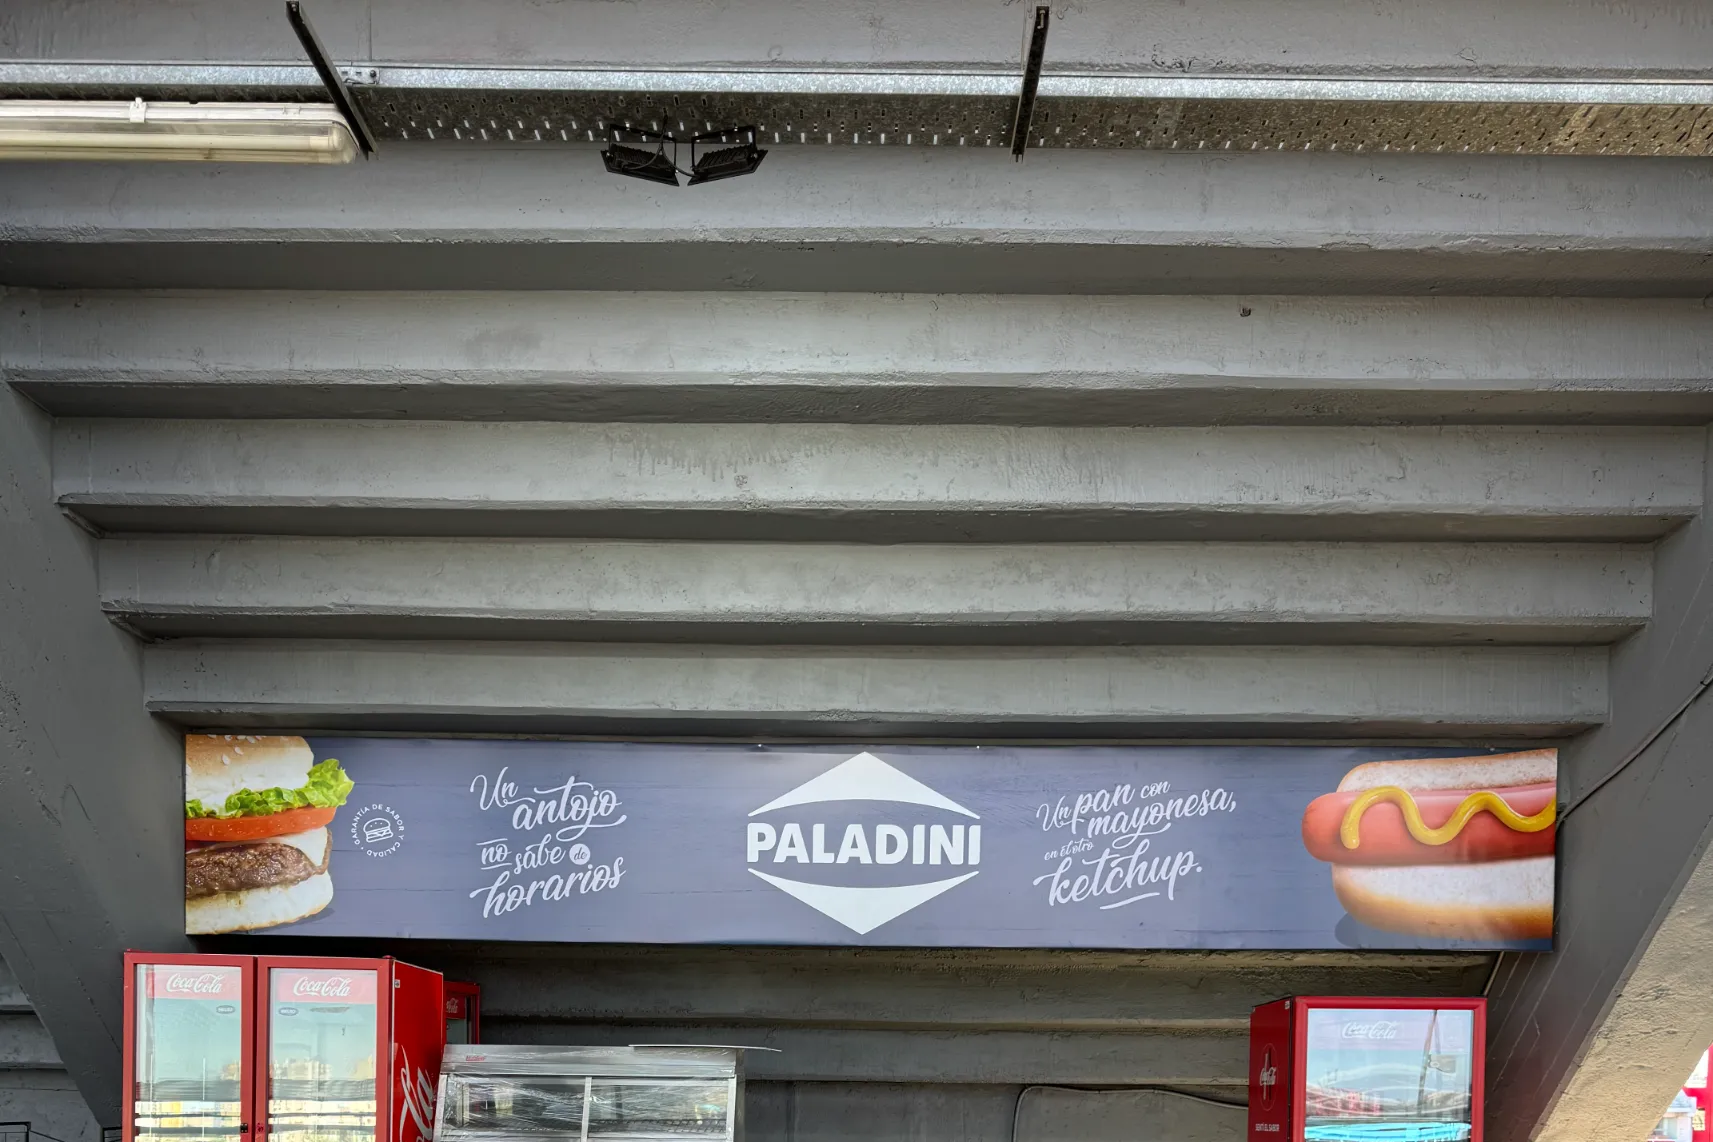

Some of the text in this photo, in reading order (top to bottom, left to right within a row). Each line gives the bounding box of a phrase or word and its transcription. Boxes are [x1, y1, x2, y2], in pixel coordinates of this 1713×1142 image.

[372, 803, 383, 811] DE
[469, 766, 536, 811] Un
[512, 775, 627, 842] antojo
[1036, 780, 1171, 834] Un pan con
[385, 806, 405, 832] SABOR
[1087, 788, 1237, 849] mayonesa,
[366, 841, 401, 858] CALIDAD
[481, 833, 588, 874] no sabe de
[746, 822, 981, 865] PALADINI
[1044, 850, 1059, 861] en
[469, 856, 627, 918] horarios
[1032, 838, 1203, 907] ketchup.
[166, 973, 225, 994] Coca-Cola
[293, 976, 352, 997] Coca-Cola
[1341, 1020, 1398, 1040] Coca-Cola
